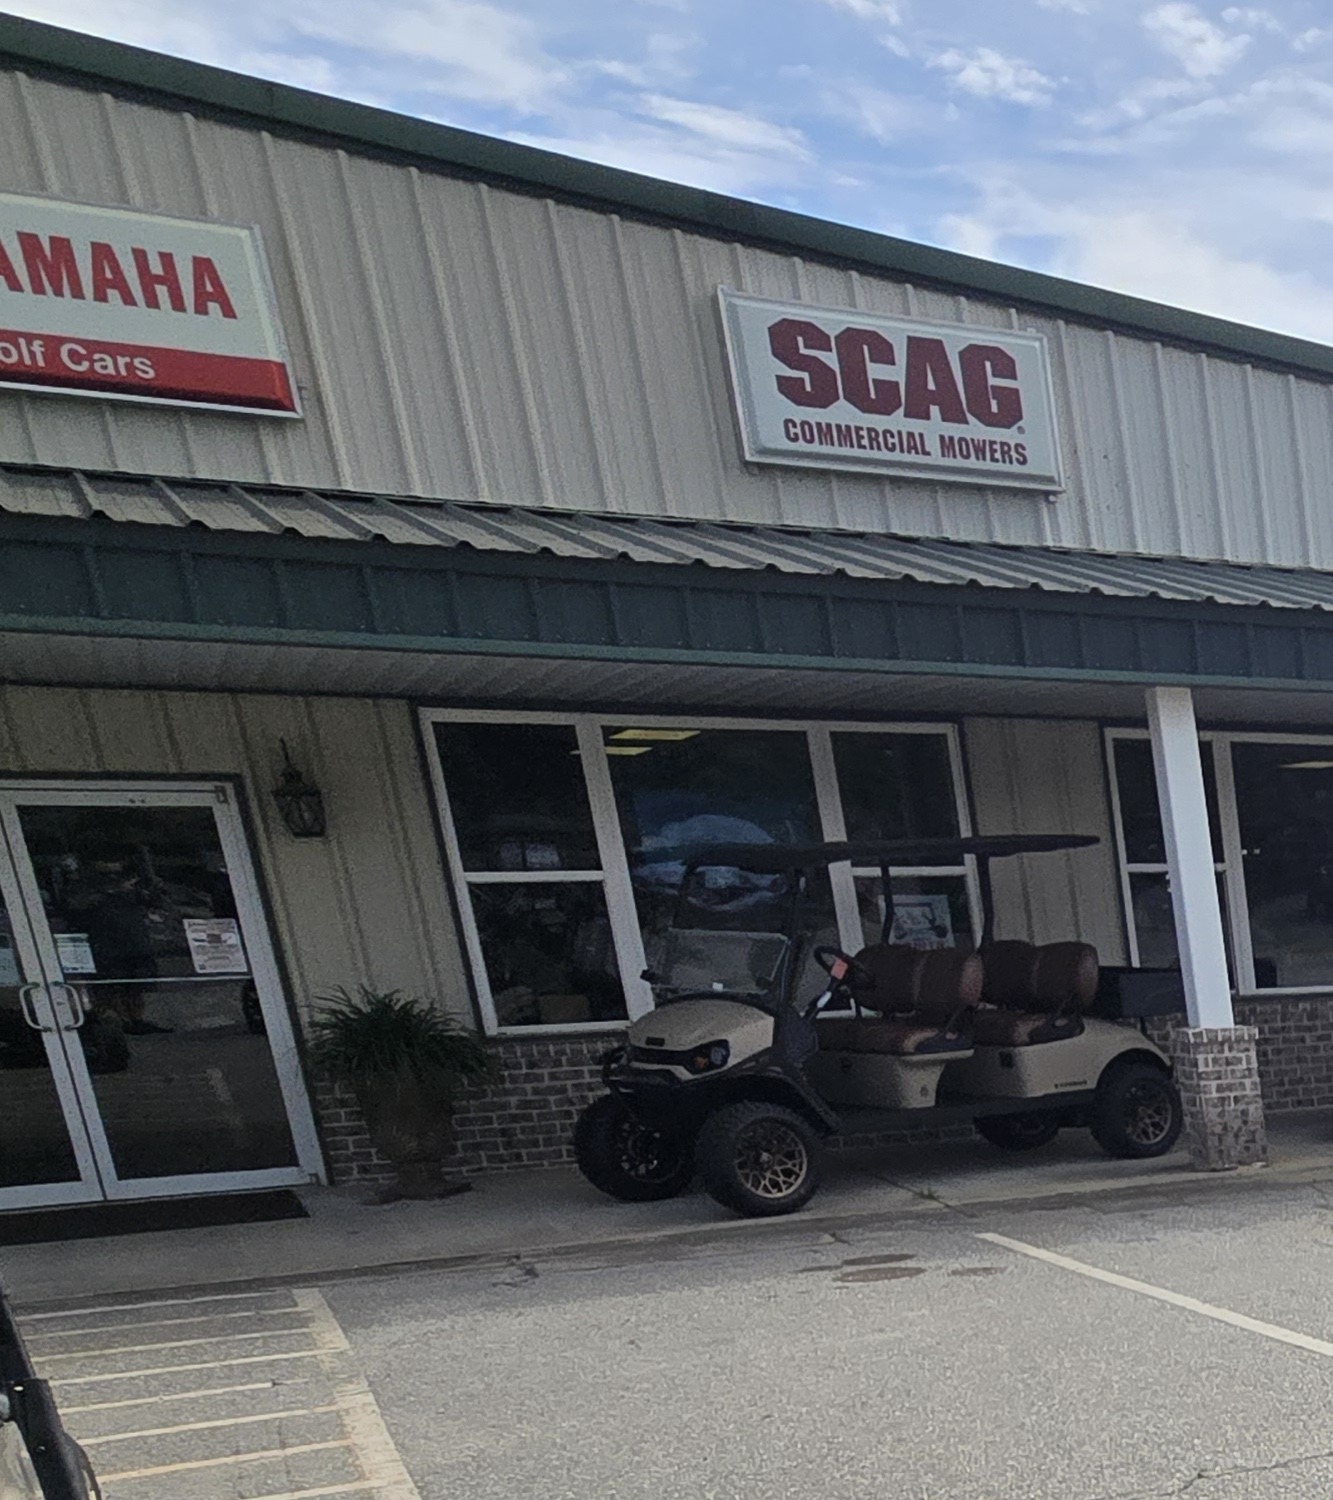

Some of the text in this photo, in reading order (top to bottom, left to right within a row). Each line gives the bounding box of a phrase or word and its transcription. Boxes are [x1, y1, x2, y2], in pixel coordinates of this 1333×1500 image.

[60, 342, 156, 380] Cars
[768, 318, 1023, 429] SCAG
[784, 420, 1028, 466] COMMERCIAL MOWERS
